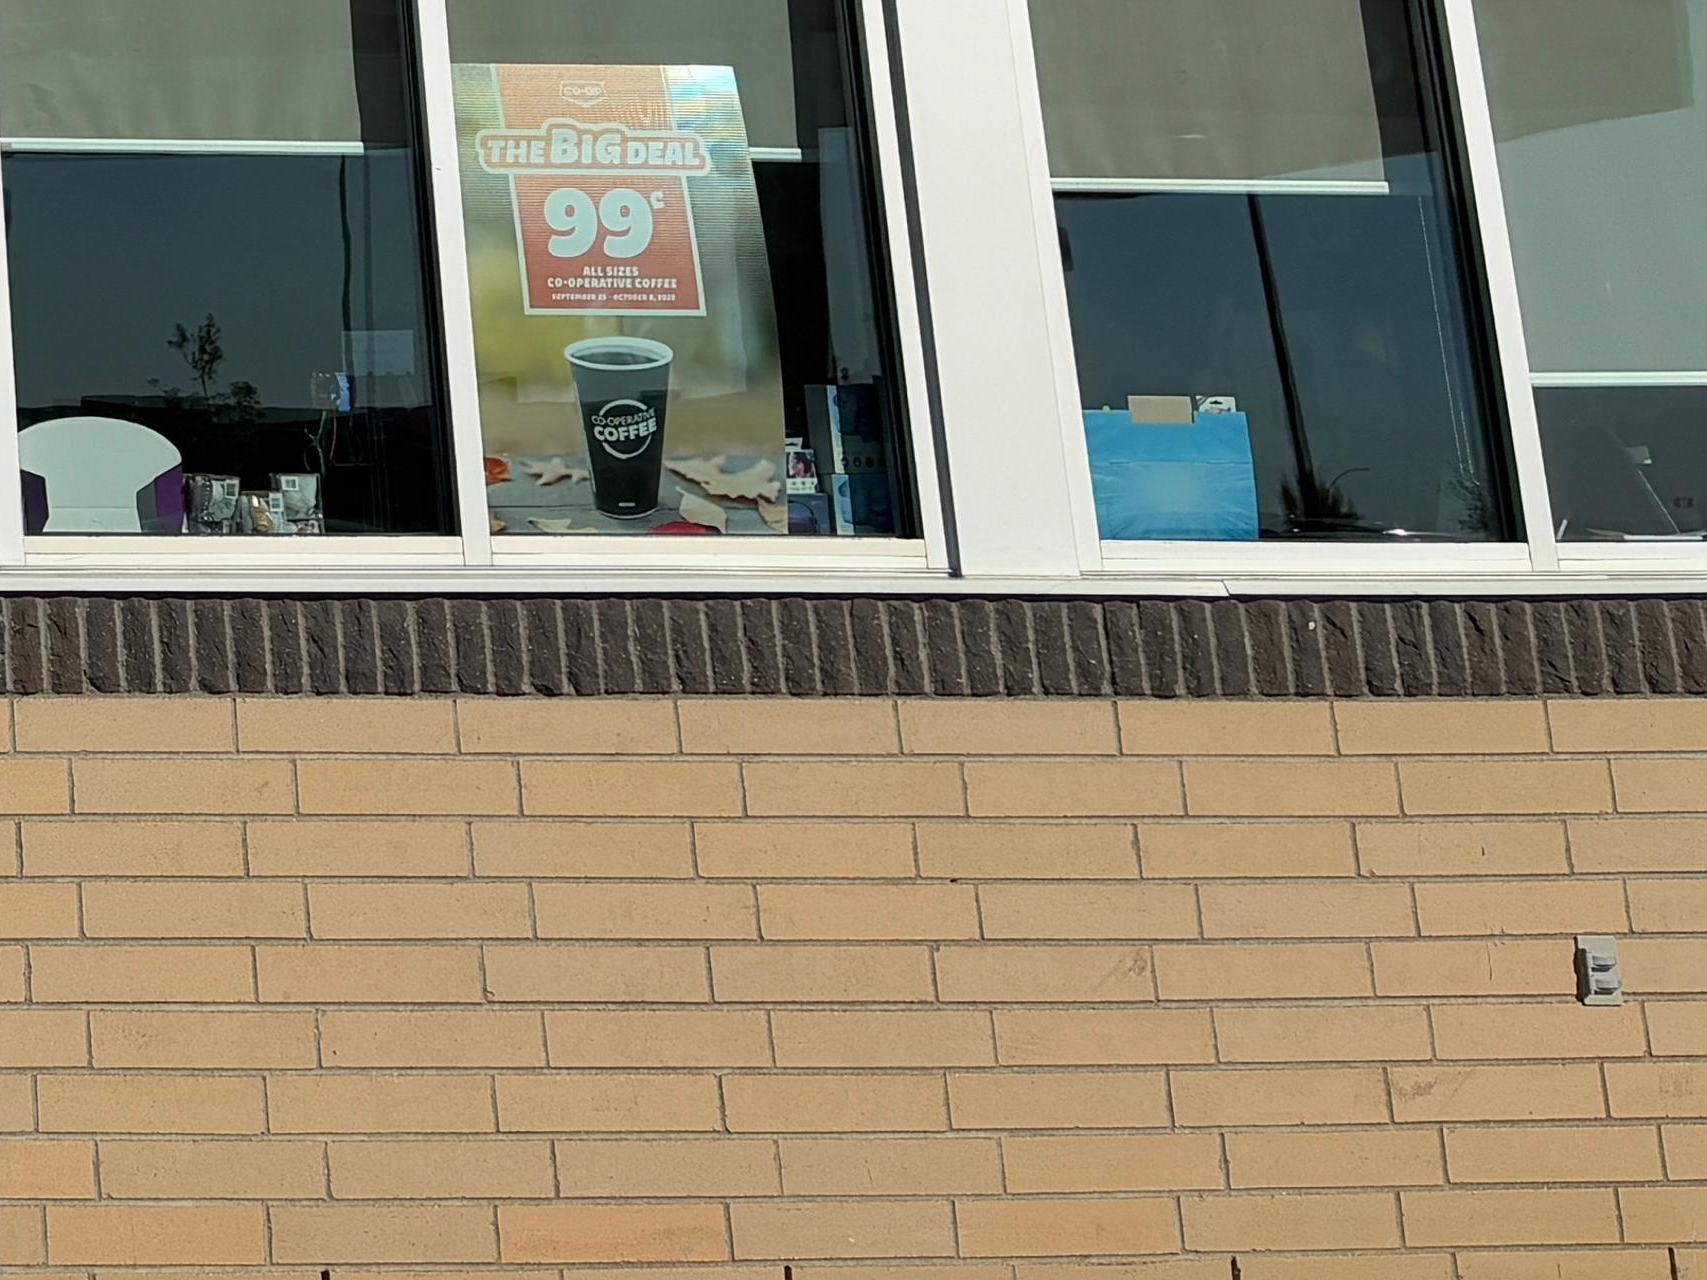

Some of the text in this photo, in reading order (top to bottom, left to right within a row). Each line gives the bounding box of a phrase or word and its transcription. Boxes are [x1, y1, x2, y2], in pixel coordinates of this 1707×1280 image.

[563, 86, 602, 96] CO-OP
[487, 128, 700, 165] THE BIG DEAL
[583, 266, 639, 276] ALL SIZES
[635, 278, 677, 288] COFFEE
[551, 293, 596, 301] SEPTEMBER
[613, 293, 647, 301] OCTOBER
[592, 417, 657, 441] COFFEE
